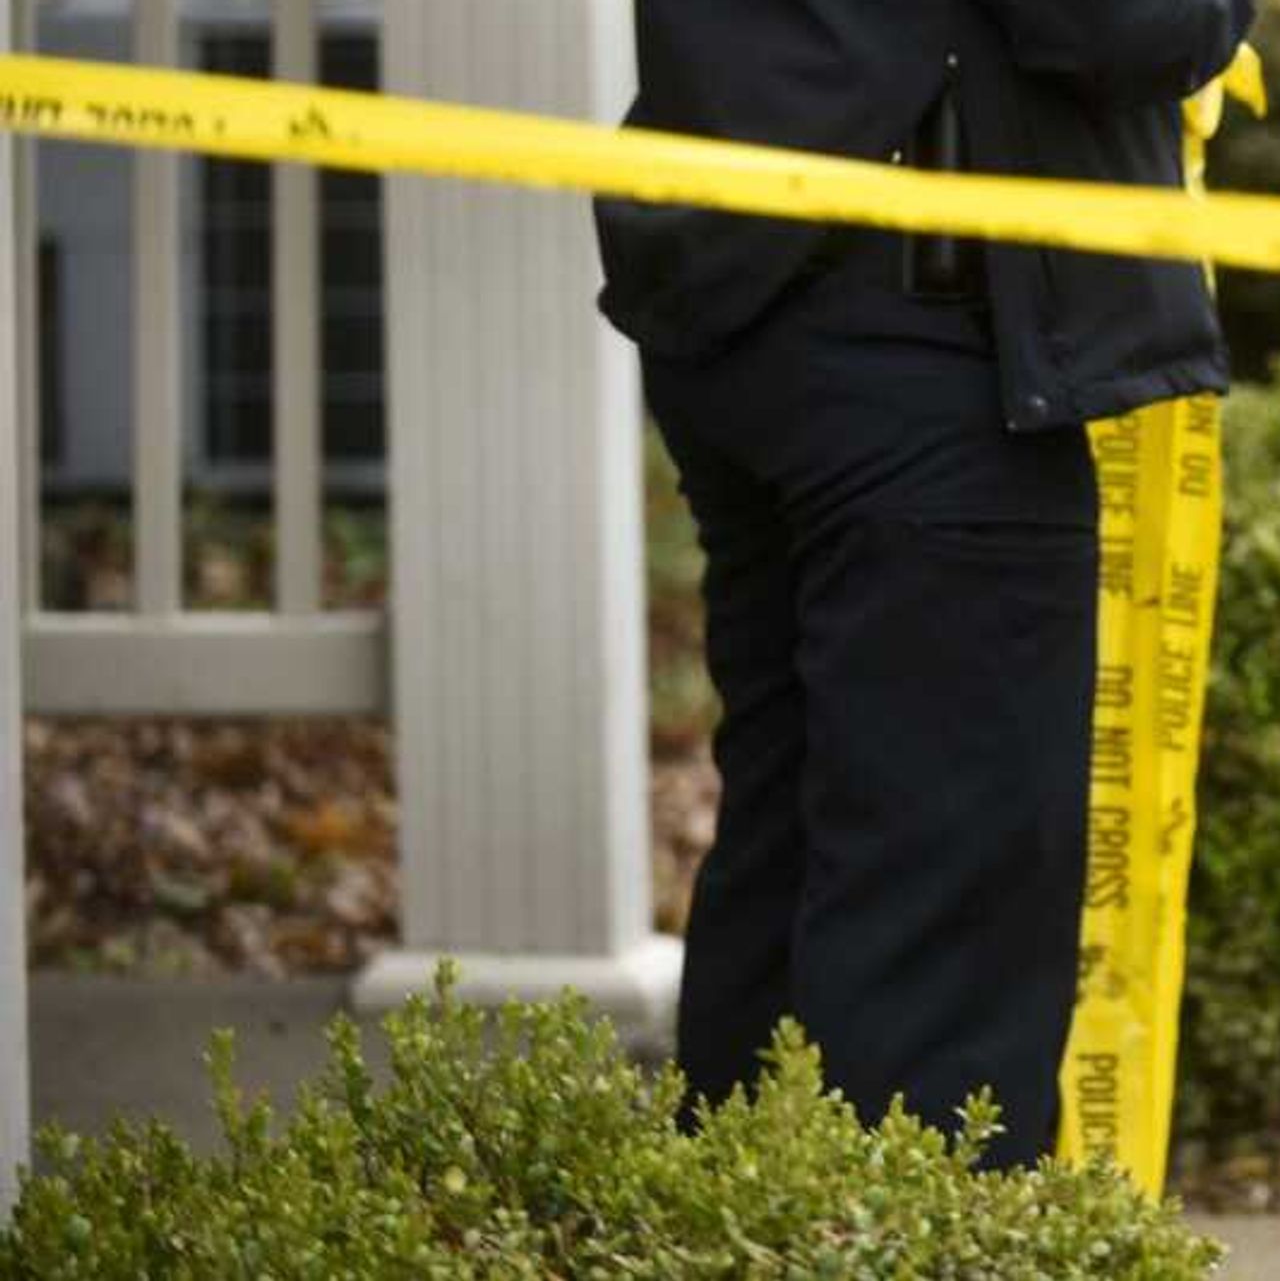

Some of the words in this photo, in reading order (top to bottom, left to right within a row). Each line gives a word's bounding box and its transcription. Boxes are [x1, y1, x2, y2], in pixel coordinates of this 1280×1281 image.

[1179, 452, 1213, 498] DO
[1095, 665, 1134, 709] DO
[1092, 726, 1132, 789] NOT
[1086, 805, 1131, 910] CROSS
